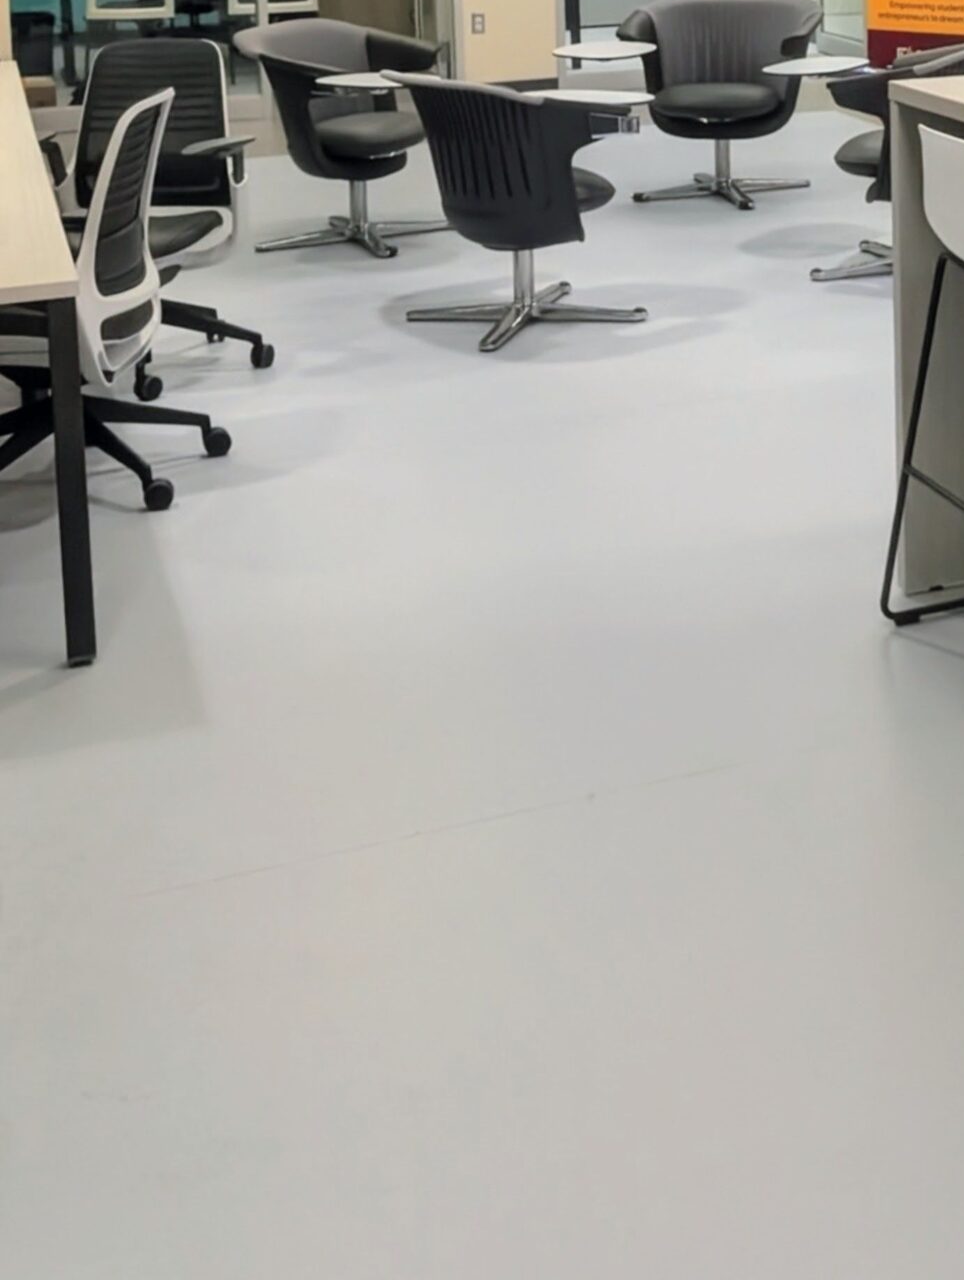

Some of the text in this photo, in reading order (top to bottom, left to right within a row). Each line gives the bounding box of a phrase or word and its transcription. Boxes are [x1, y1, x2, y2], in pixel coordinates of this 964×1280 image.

[889, 0, 964, 12] Empowering student
[938, 14, 964, 23] dream
